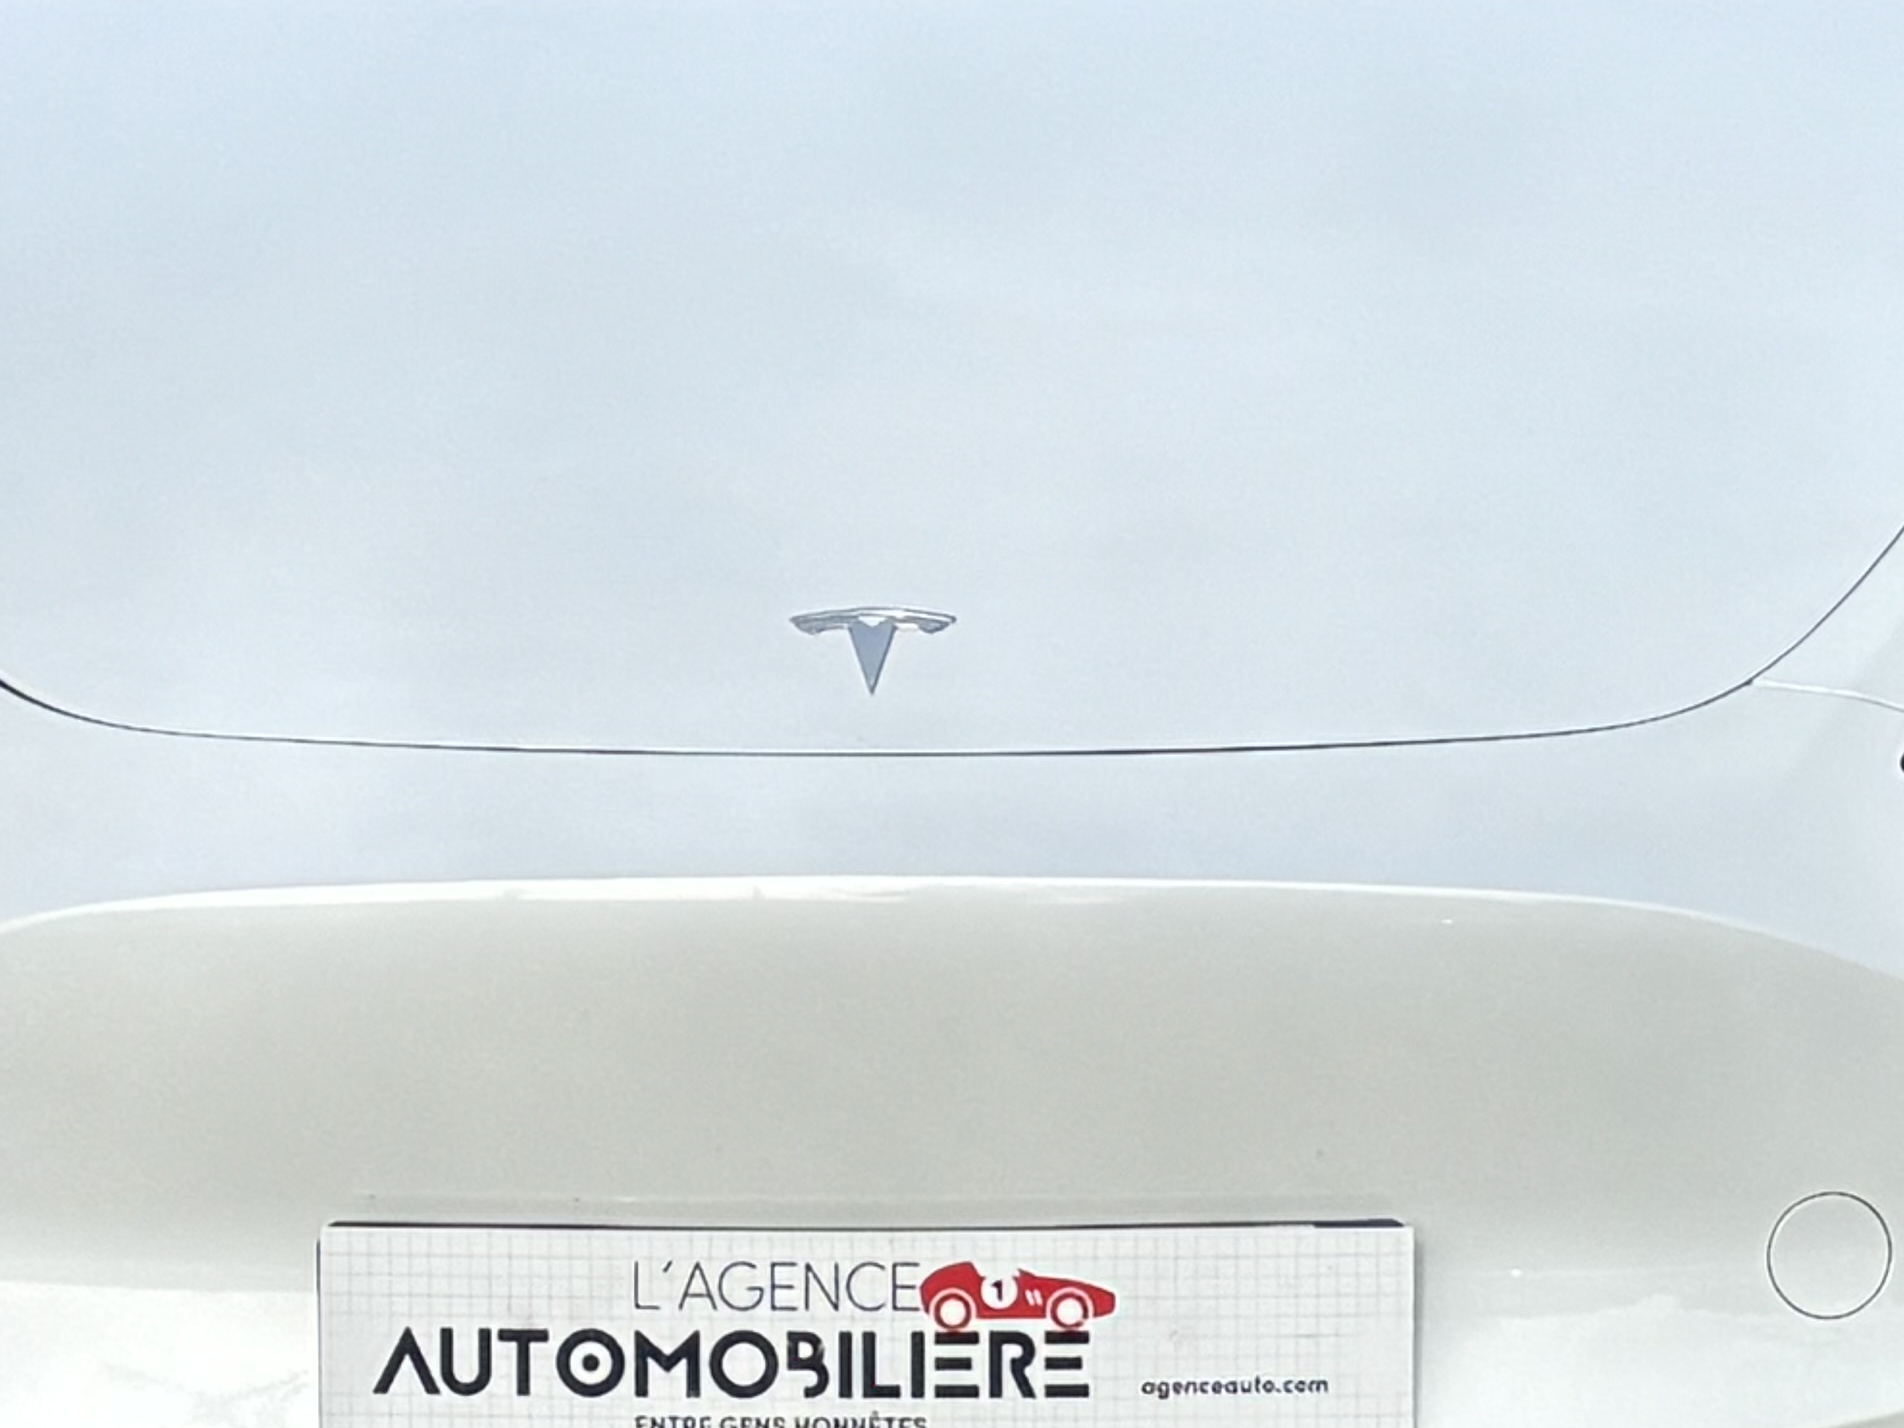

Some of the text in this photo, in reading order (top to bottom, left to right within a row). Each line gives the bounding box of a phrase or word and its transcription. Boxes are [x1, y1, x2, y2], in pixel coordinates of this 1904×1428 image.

[633, 1260, 921, 1313] L'AGENCE
[990, 1279, 1004, 1302] 1
[1140, 1375, 1329, 1400] agenceauto.com
